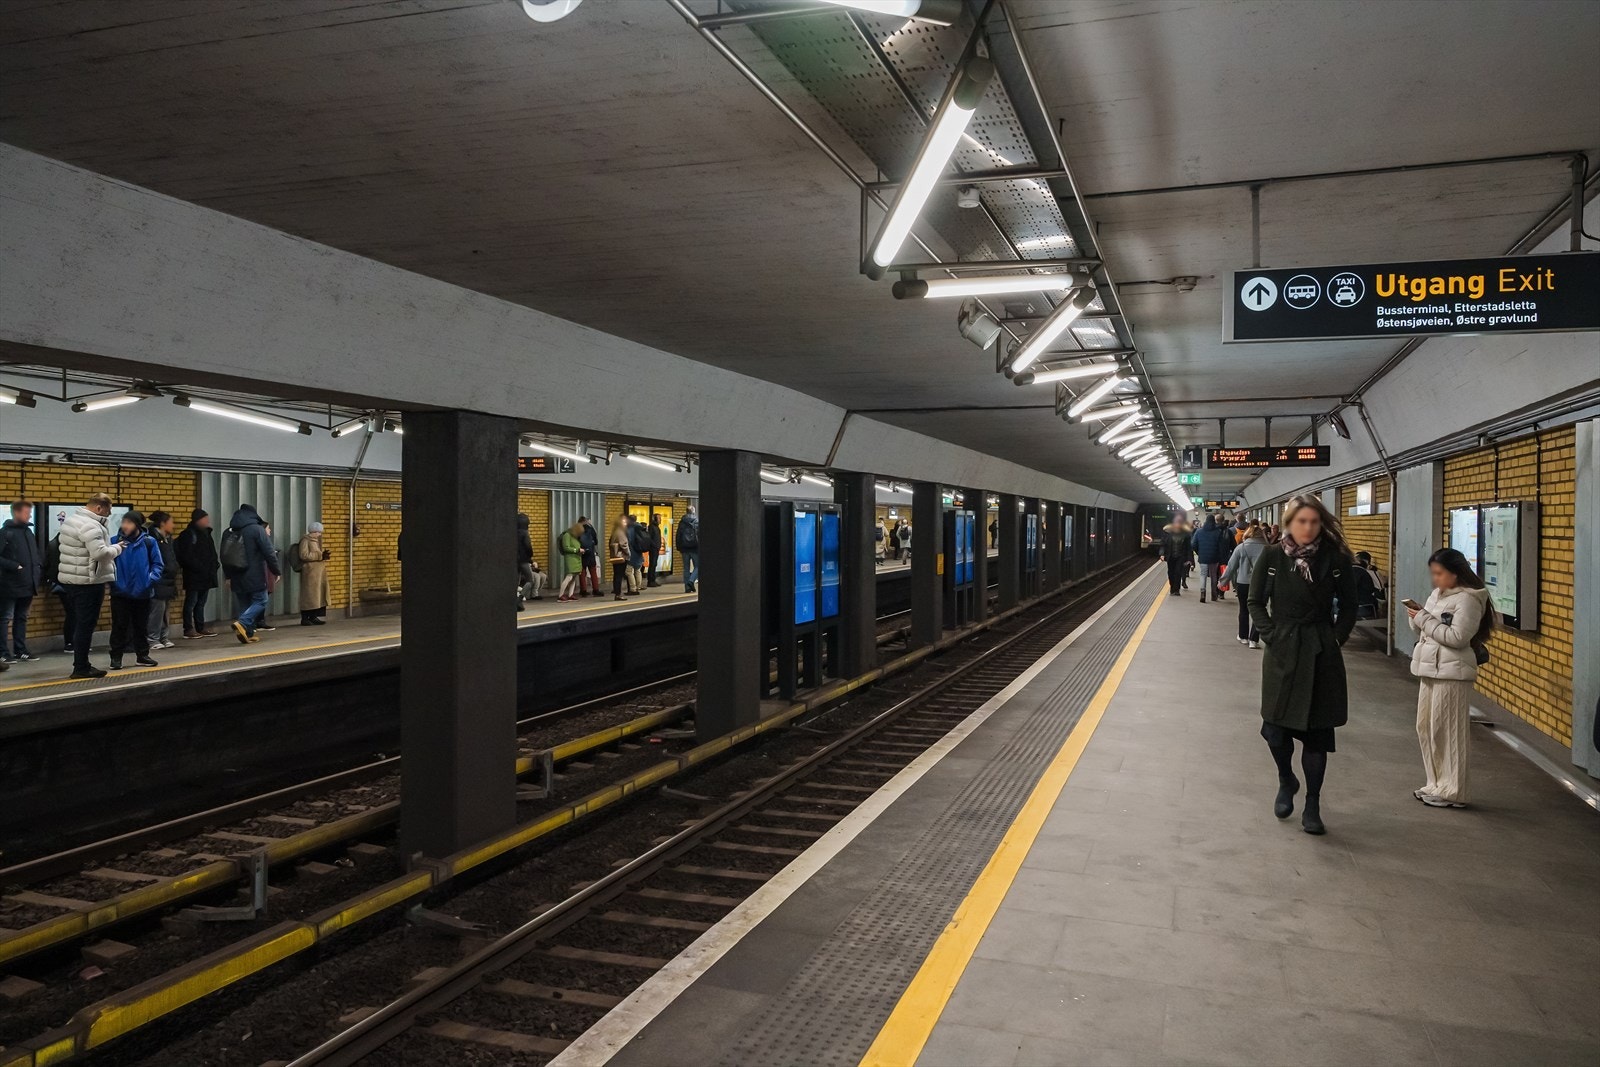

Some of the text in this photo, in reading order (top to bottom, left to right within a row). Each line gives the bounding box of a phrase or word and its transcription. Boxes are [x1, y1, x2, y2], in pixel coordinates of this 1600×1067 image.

[1376, 267, 1555, 301] Utgang Exit
[1376, 301, 1537, 315] Bussterminal, Etterstadsletta
[1376, 313, 1538, 328] Østensjøveien, Østre gravlund
[563, 458, 570, 468] 2
[1188, 450, 1194, 463] 1
